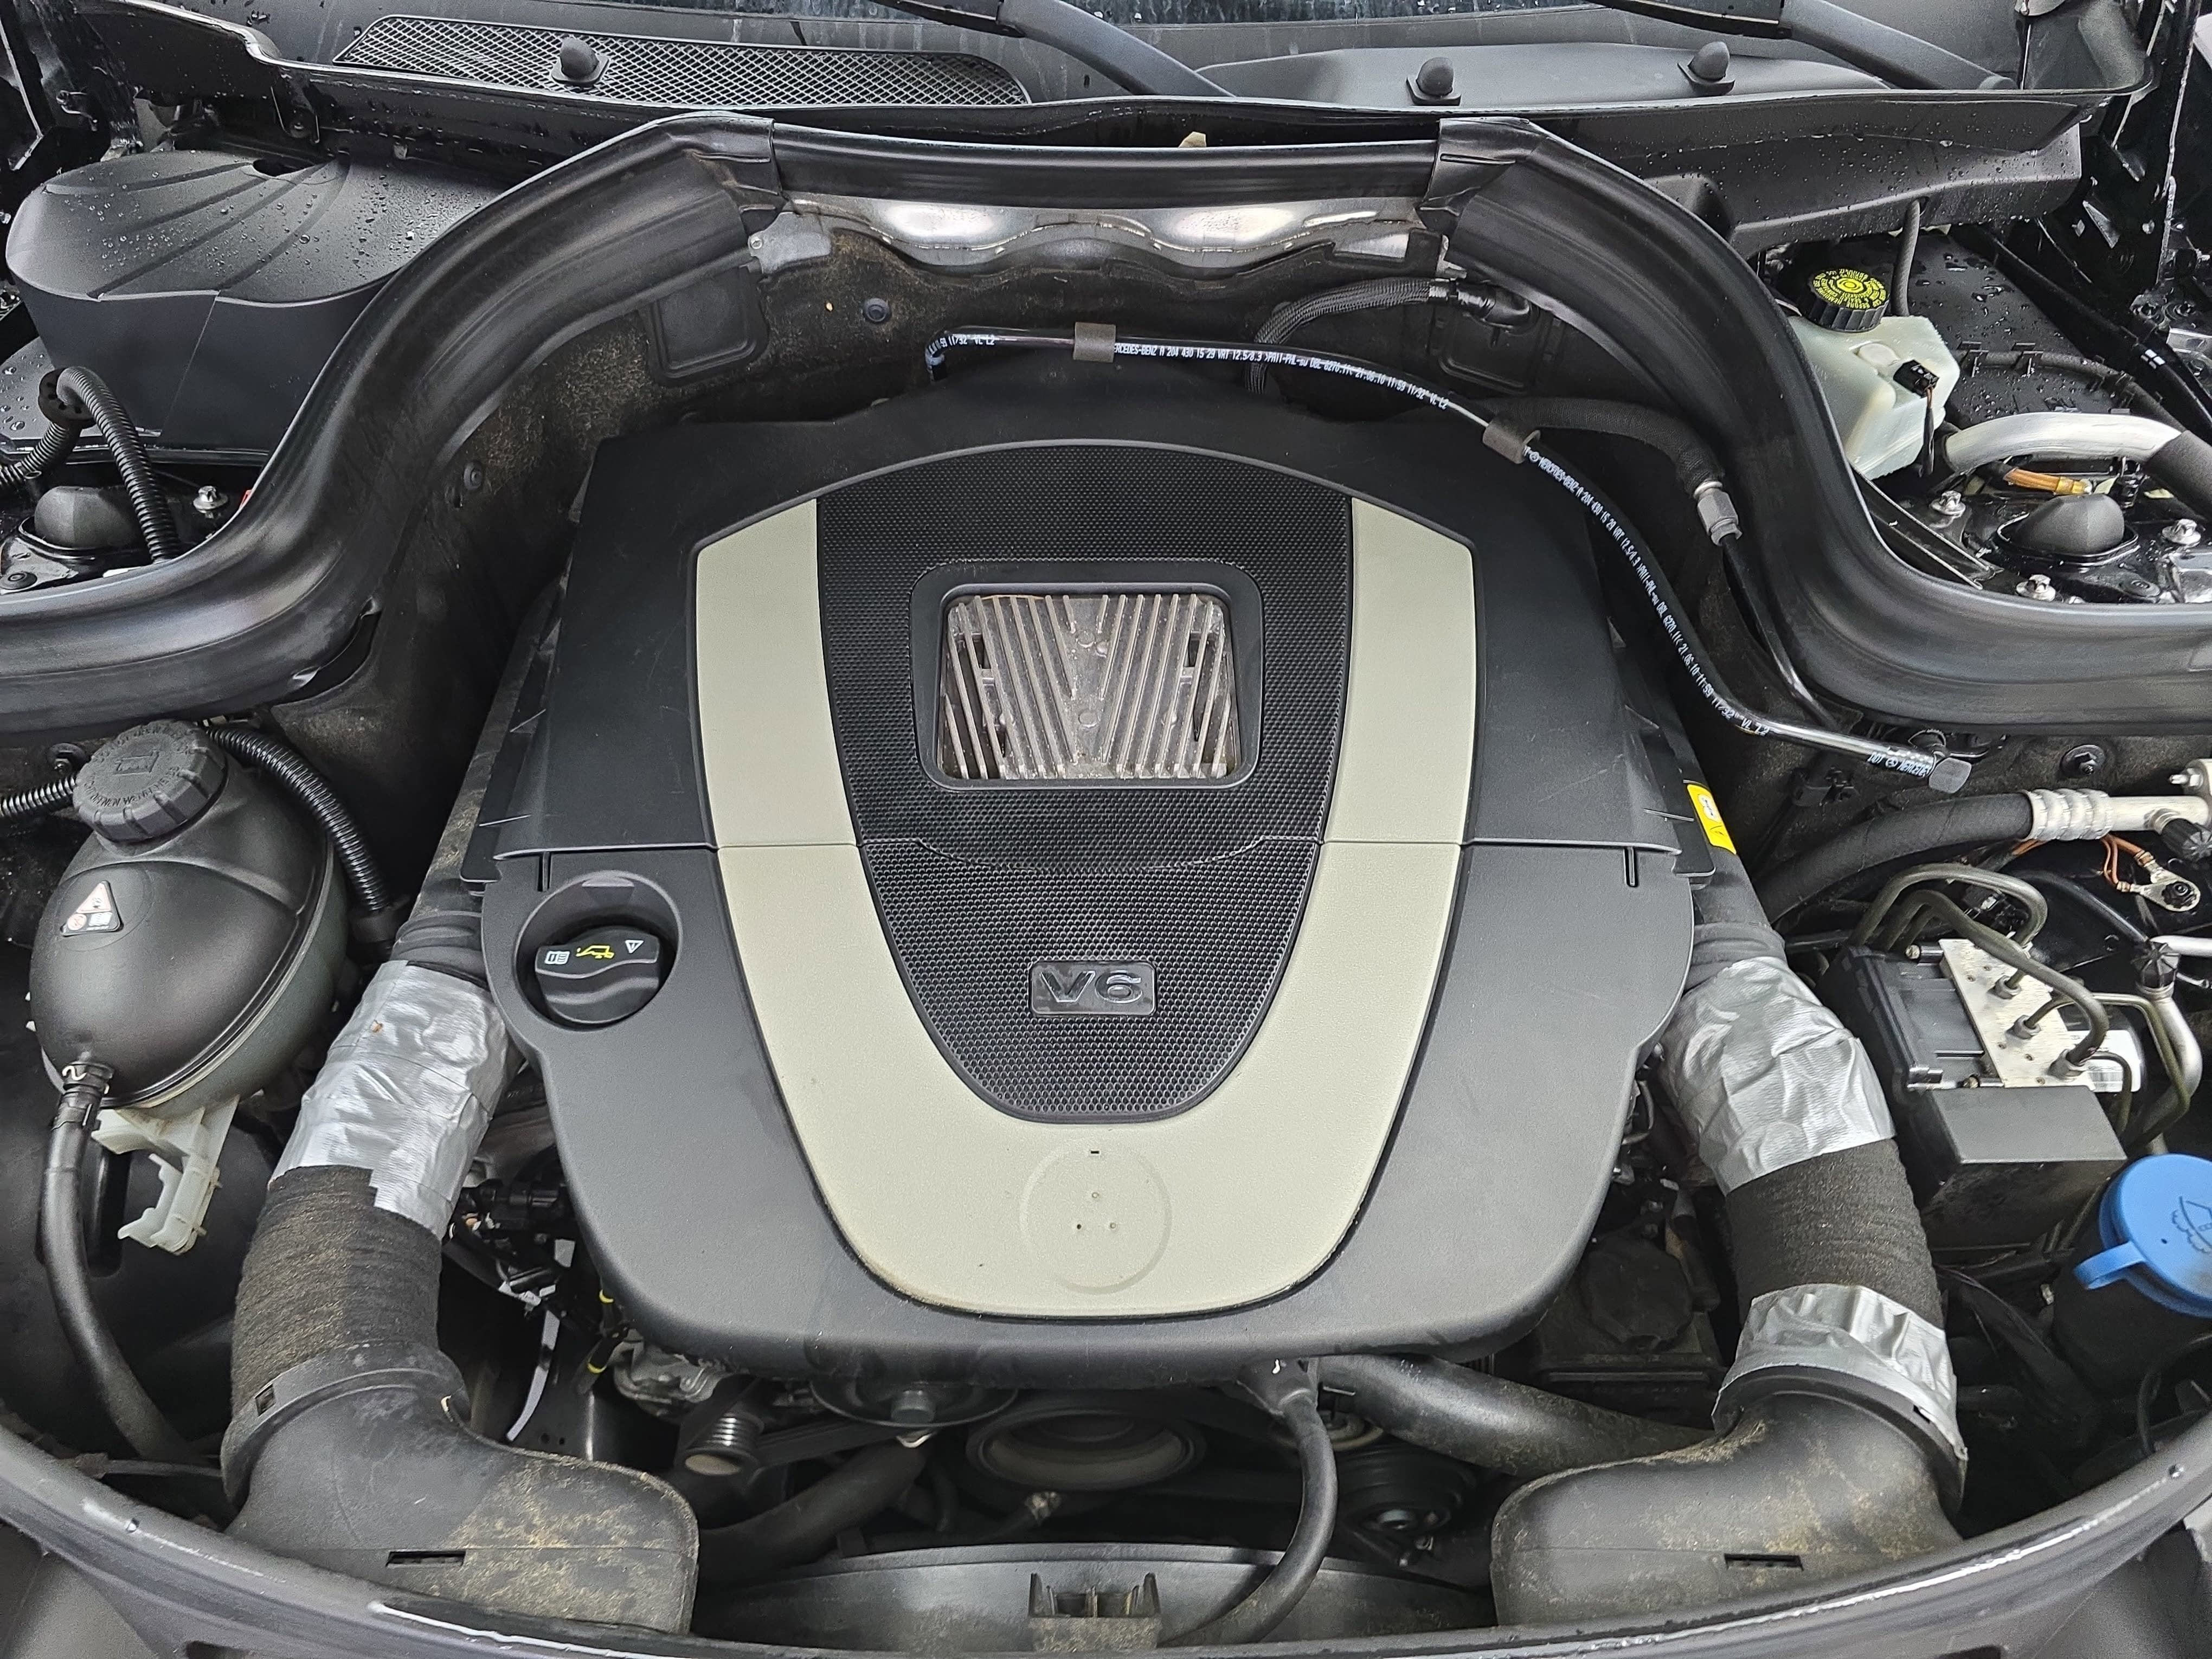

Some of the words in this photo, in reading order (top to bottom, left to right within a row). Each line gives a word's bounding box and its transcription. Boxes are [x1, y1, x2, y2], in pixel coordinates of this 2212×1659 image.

[1114, 343, 1157, 356] ERCEDES-BENZ
[1166, 346, 1179, 357] 204
[1181, 347, 1193, 358] 430
[1196, 348, 1205, 358] 15
[1206, 349, 1216, 359] 29
[1580, 492, 1594, 506] 204
[1591, 501, 1603, 516] 430
[1600, 511, 1611, 523] 15
[1606, 518, 1617, 531] 29
[1039, 969, 1142, 1004] V6
